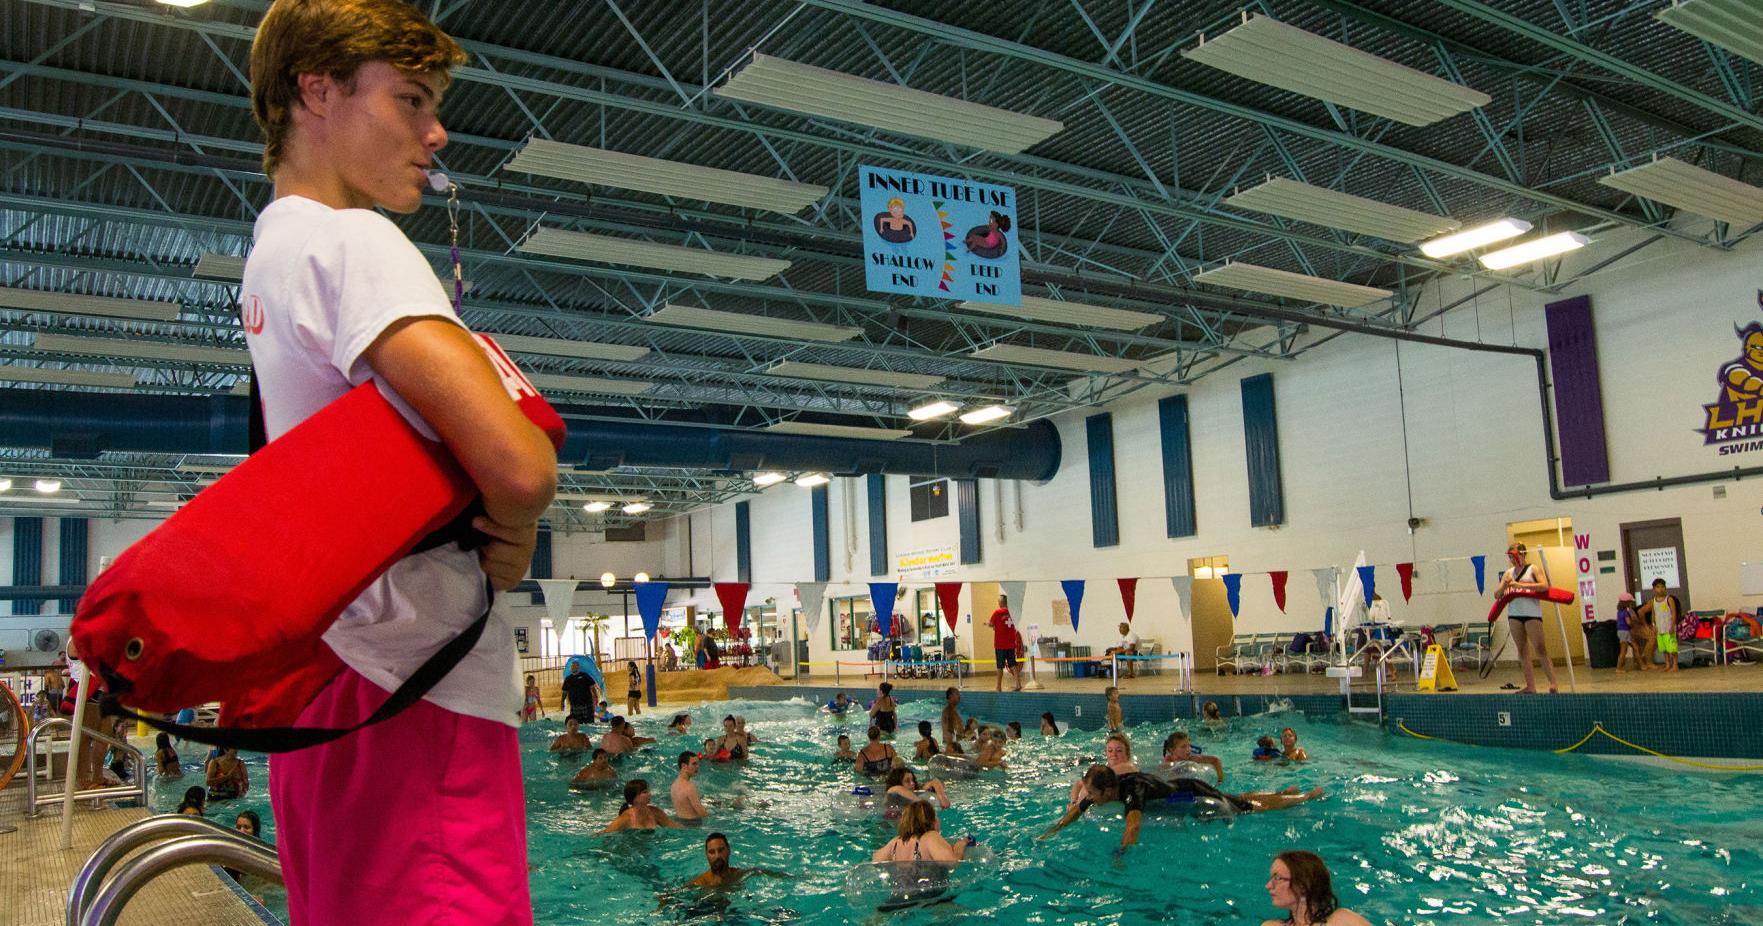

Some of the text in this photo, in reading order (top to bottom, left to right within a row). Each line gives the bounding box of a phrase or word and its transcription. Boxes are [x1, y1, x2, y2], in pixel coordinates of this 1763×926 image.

[868, 172, 1010, 208] INNER TUBE USE
[872, 252, 935, 271] SHALLOW
[970, 263, 1003, 279] DEEP
[892, 273, 919, 288] END
[975, 282, 1000, 296] END
[1716, 424, 1763, 440] KNI
[1574, 533, 1595, 621] WOME
